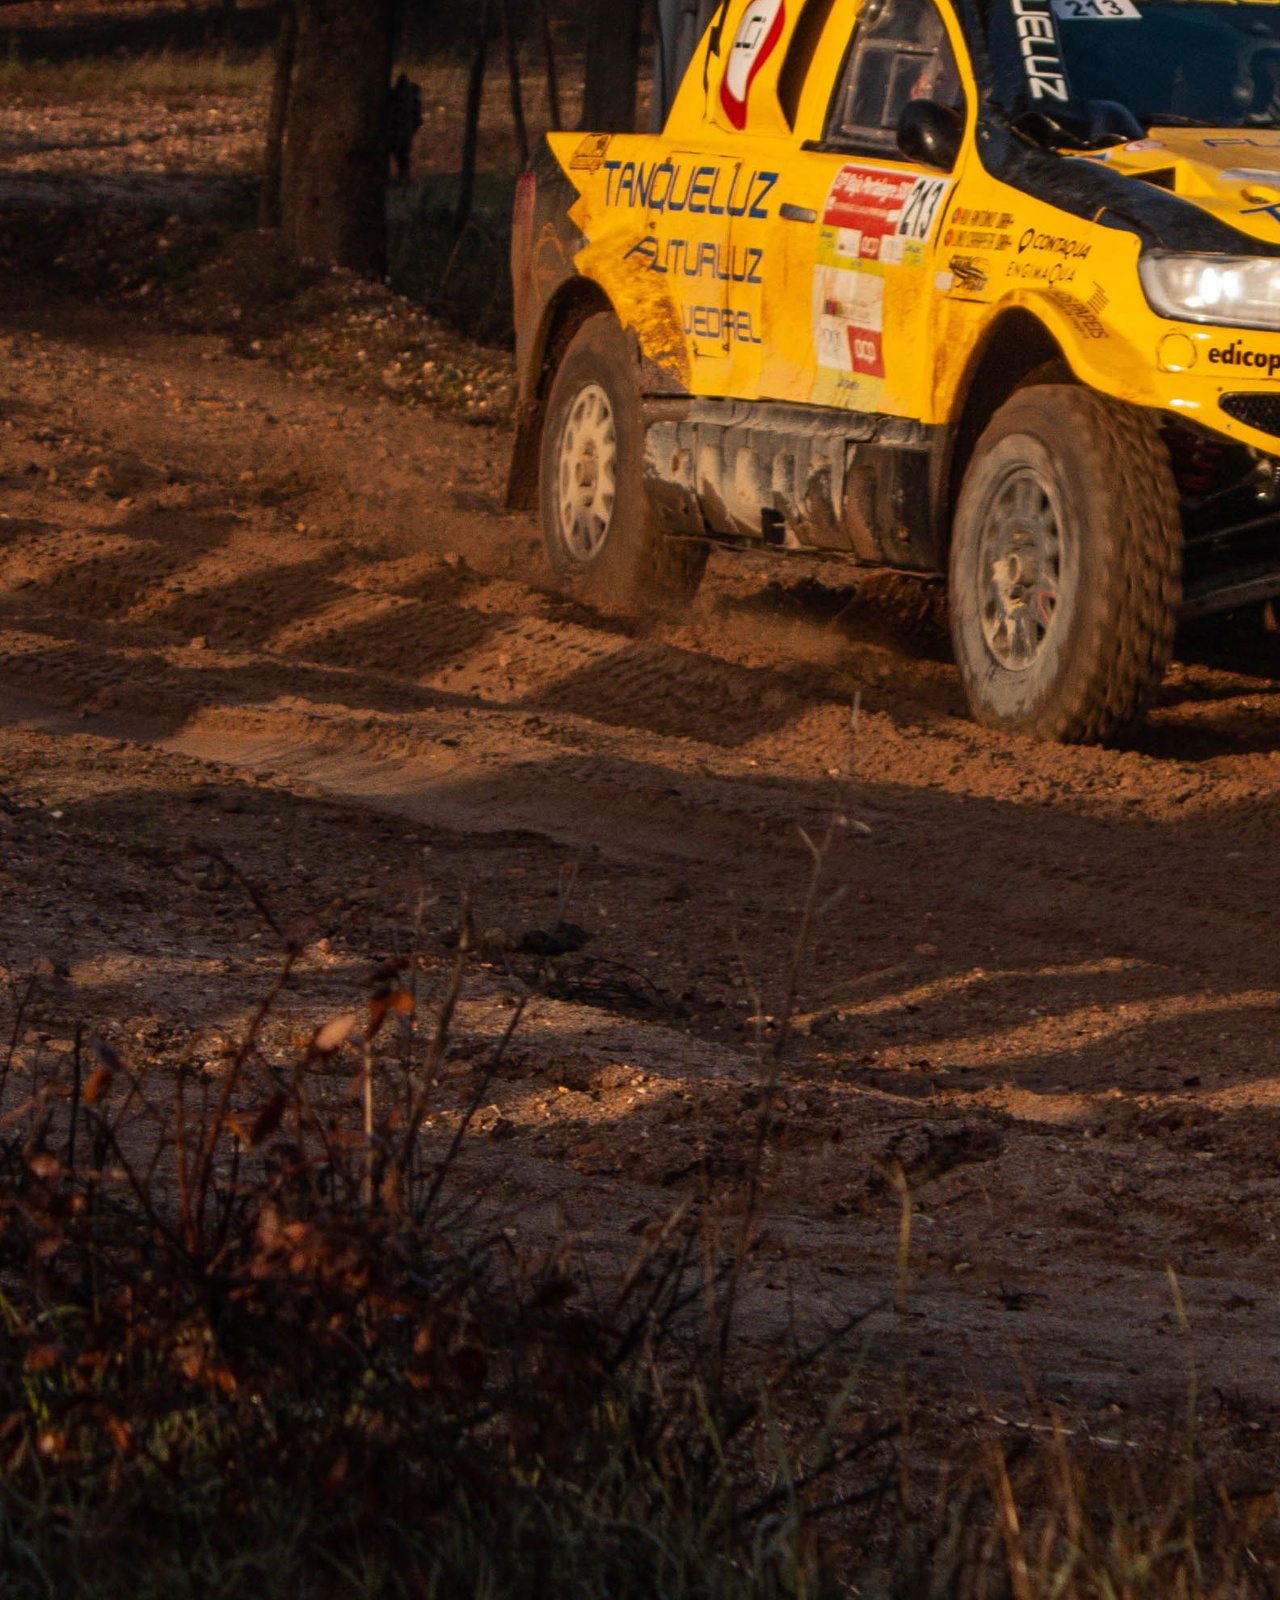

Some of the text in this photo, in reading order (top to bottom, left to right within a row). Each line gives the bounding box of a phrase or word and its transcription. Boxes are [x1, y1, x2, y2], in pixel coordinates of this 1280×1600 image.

[1065, 0, 1125, 16] 213
[603, 160, 780, 219] TANQUELUZ
[899, 180, 944, 239] 213
